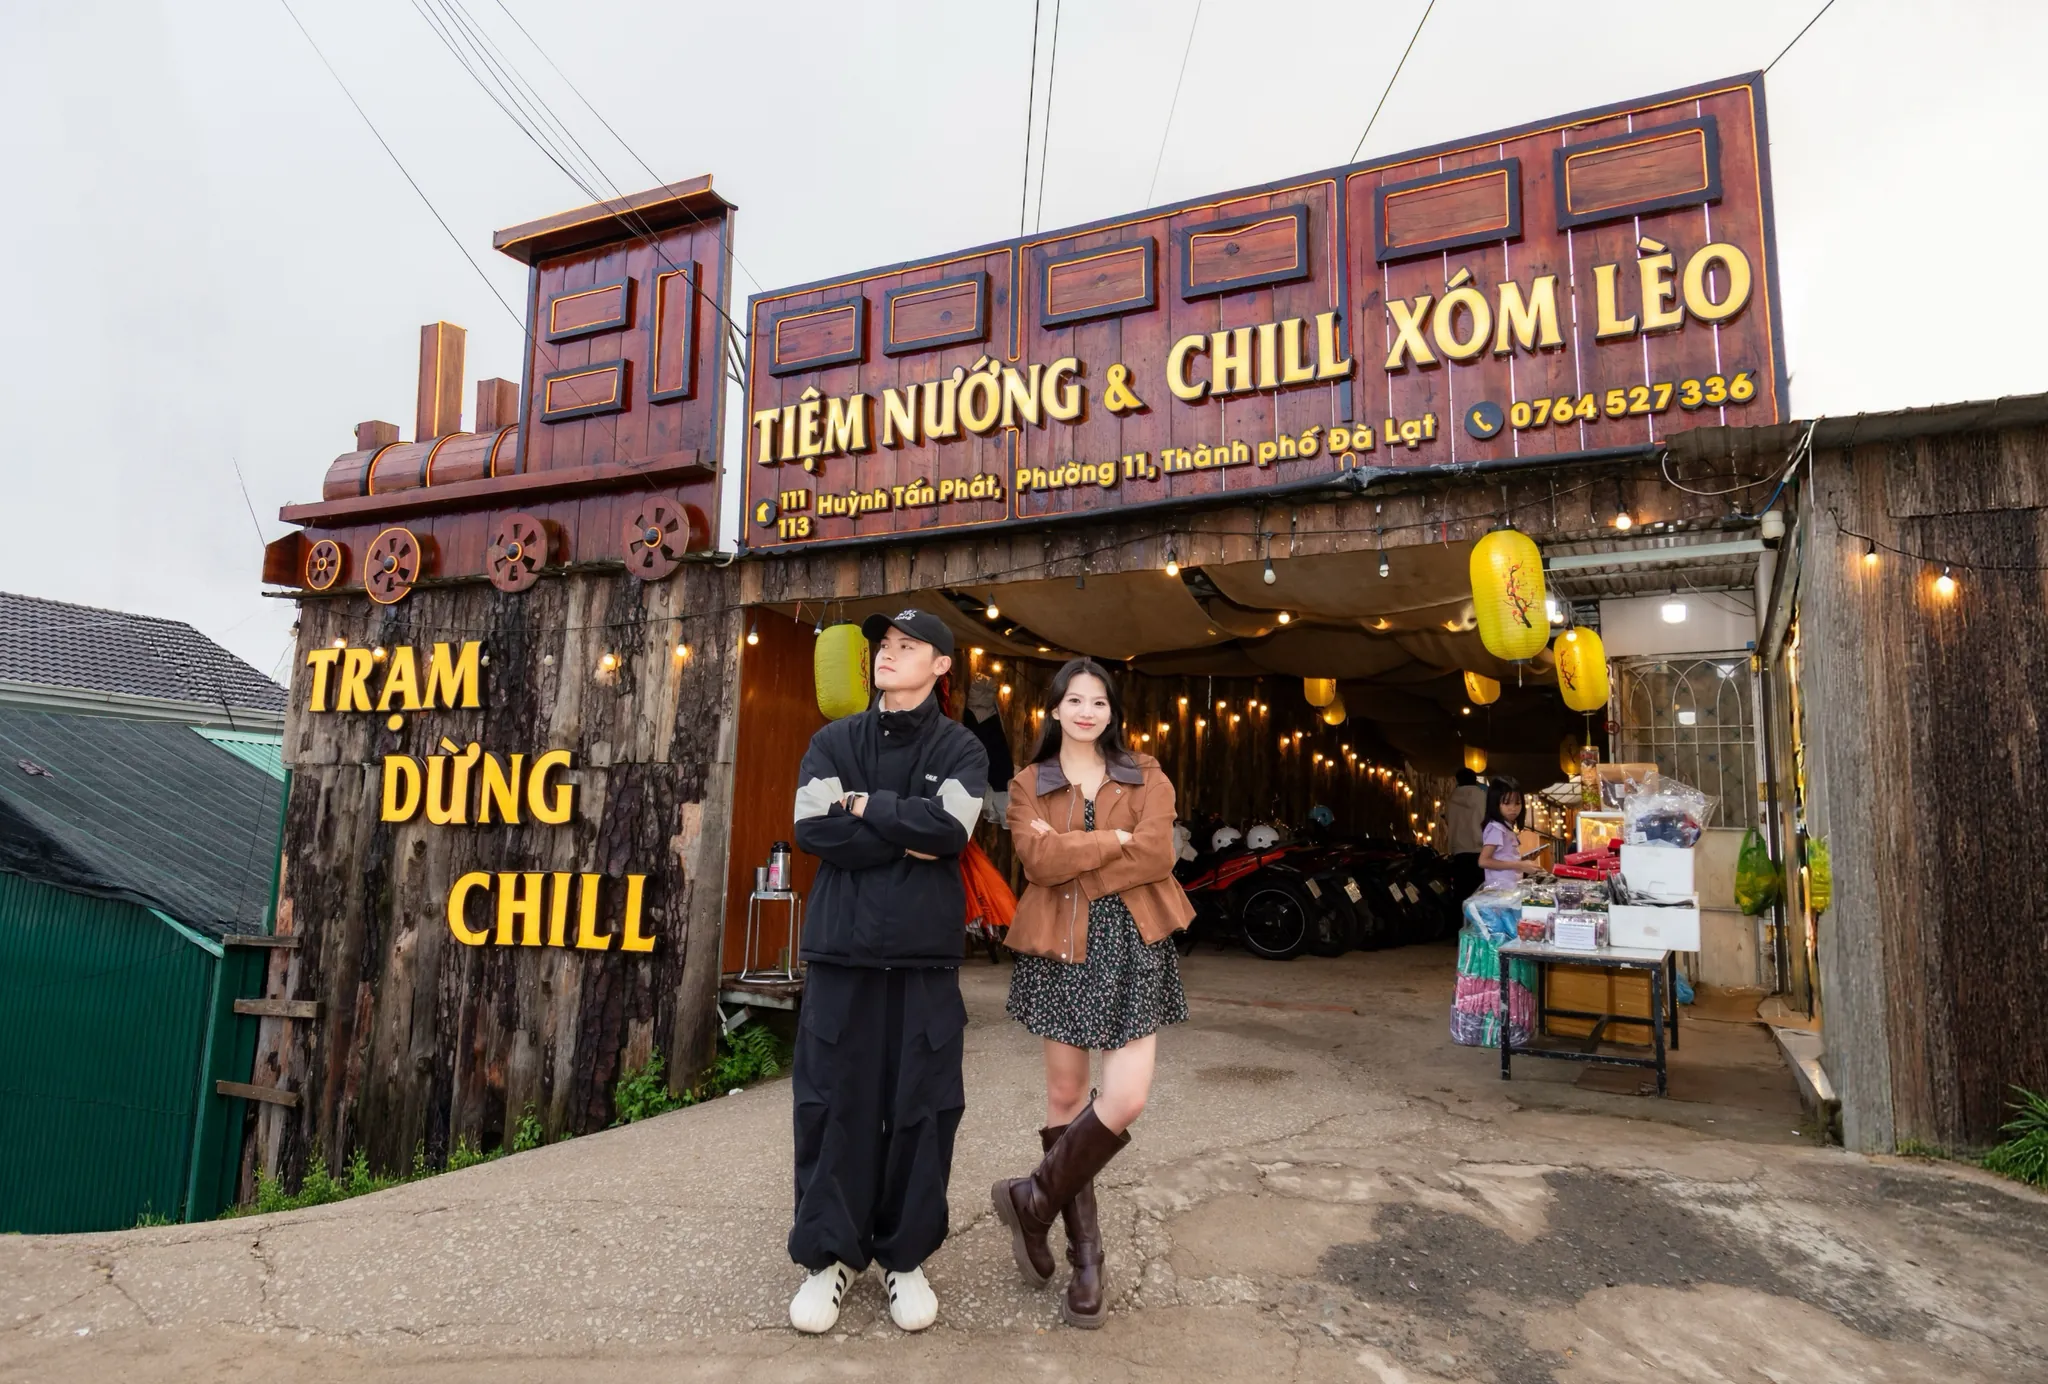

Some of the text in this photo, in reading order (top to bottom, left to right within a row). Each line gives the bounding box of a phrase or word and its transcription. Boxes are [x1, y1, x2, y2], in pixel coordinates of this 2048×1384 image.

[753, 236, 1752, 471] TIỆM NƯỚNG & CHILL XÓM LÈO
[1510, 372, 1755, 429] 0764 527 336
[780, 488, 807, 511] 111
[817, 412, 1436, 518] Huỳnh Tấn Phát, Phường 11, Thành phố Đà Lạt
[778, 516, 810, 539] 113
[306, 640, 483, 731] TRẠM
[381, 736, 573, 825] DỪNG
[447, 871, 656, 952] CHILL
